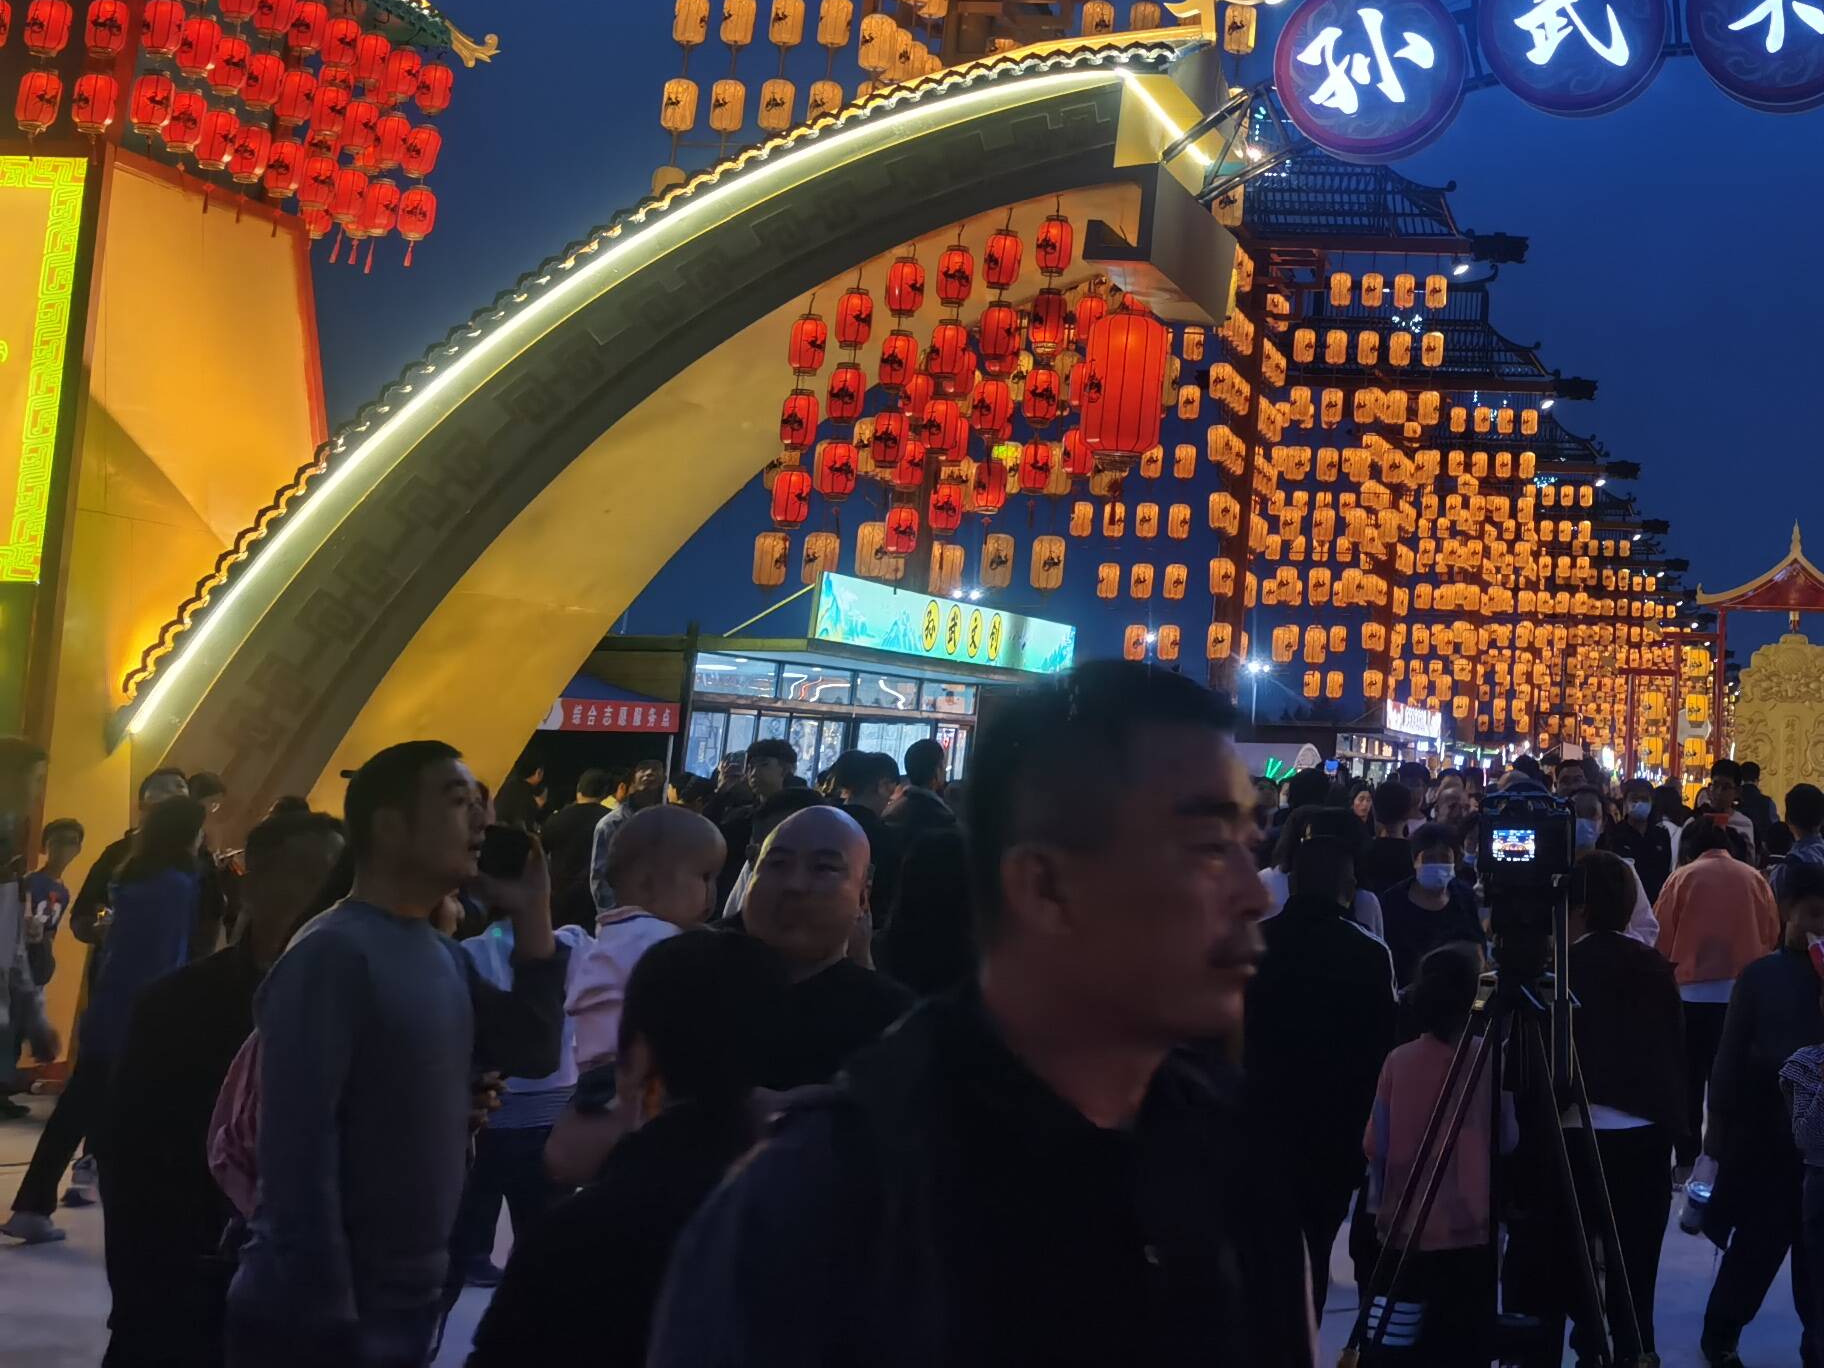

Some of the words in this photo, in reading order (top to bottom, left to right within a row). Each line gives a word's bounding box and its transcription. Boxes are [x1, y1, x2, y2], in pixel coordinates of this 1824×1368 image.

[924, 609, 1001, 653] 孙武文创
[572, 704, 671, 728] 综合志愿服务点
